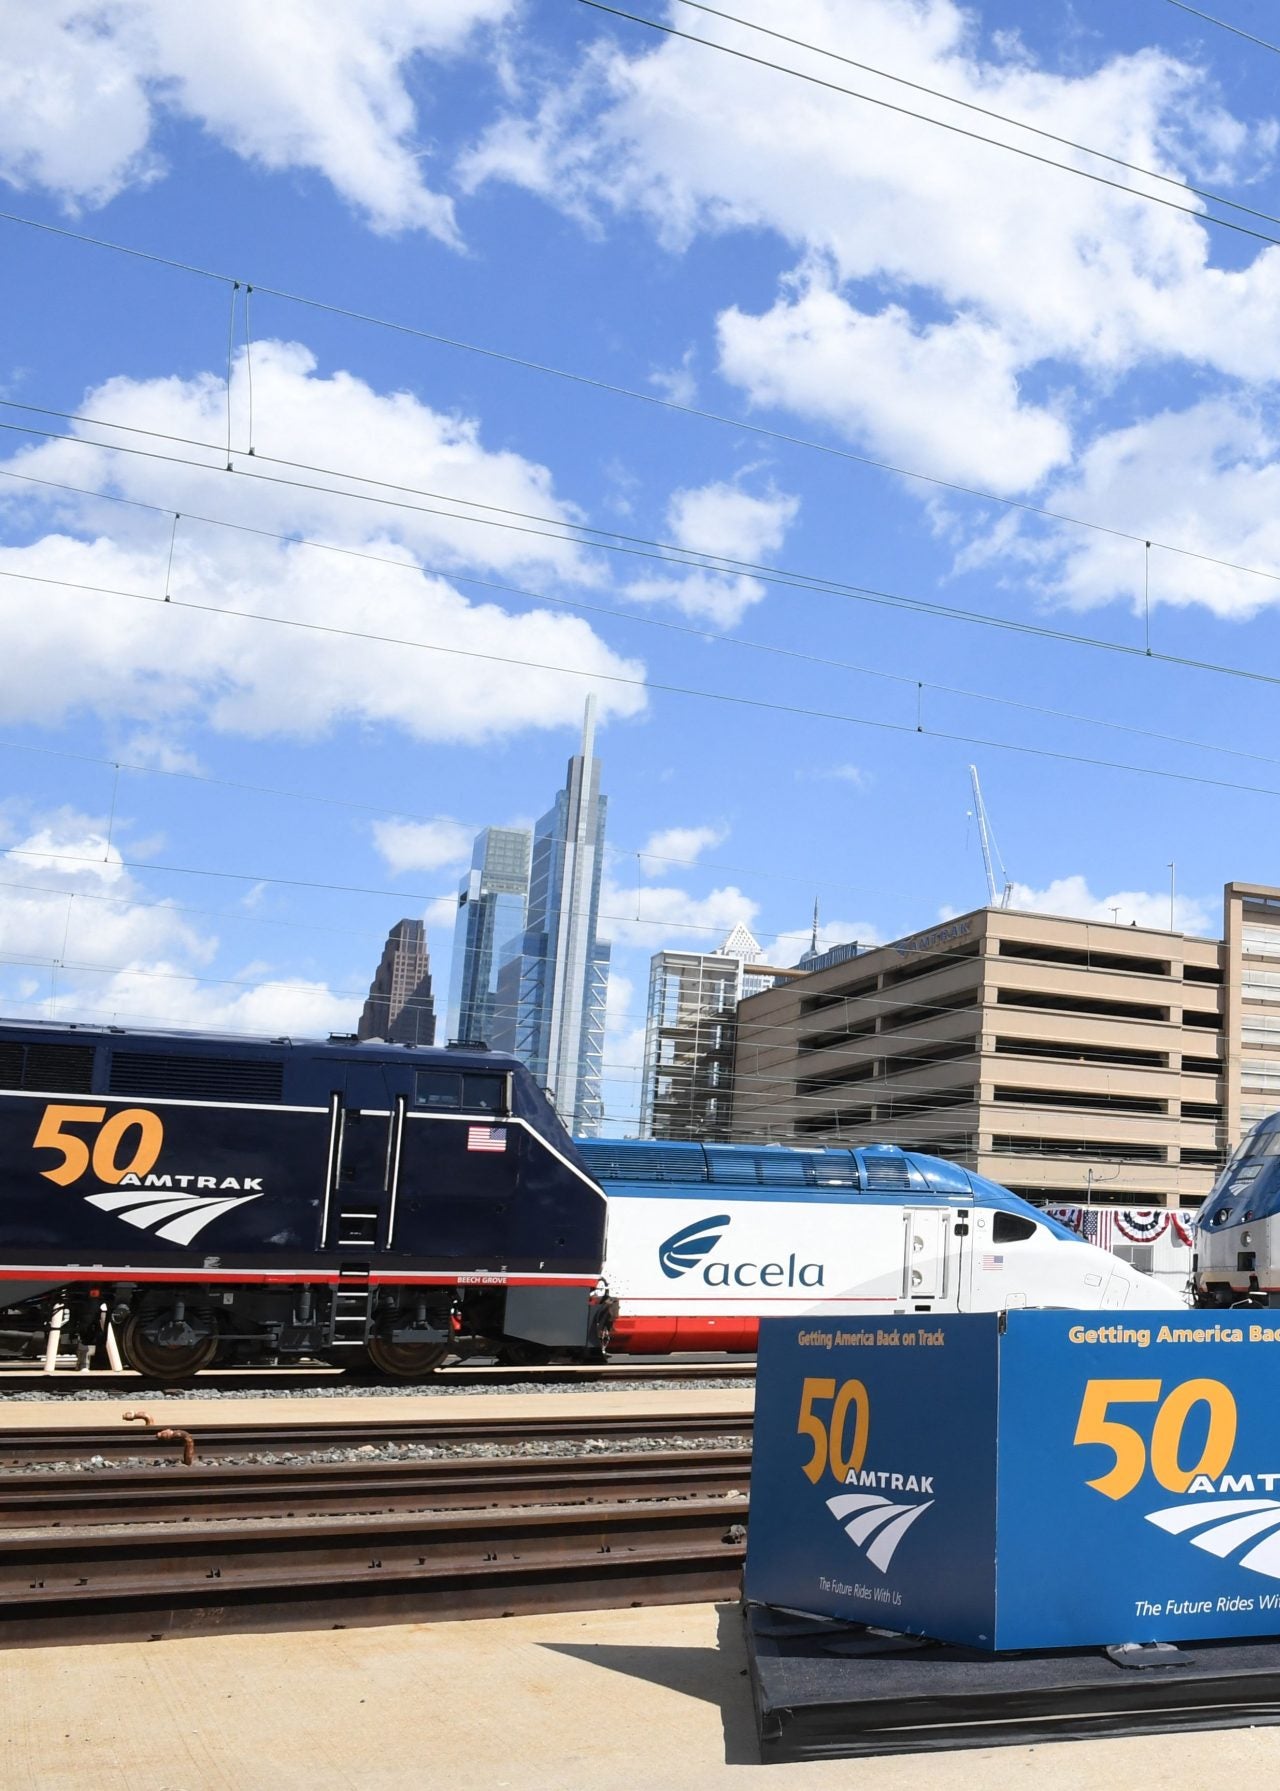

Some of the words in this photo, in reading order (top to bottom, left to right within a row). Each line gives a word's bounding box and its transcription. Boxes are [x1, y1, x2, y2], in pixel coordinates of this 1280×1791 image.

[911, 922, 971, 950] AMTRAK
[32, 1104, 164, 1187] 50
[120, 1173, 263, 1192] AMTRAK
[457, 1276, 481, 1284] BEECH
[703, 1253, 824, 1288] acela
[798, 1329, 832, 1349] Getting
[834, 1330, 874, 1346] America
[876, 1329, 900, 1346] Back
[902, 1332, 916, 1346] on
[918, 1329, 945, 1346] Track
[1069, 1325, 1151, 1347] Getting
[1156, 1325, 1243, 1342] America
[797, 1377, 871, 1485] 50
[1073, 1378, 1238, 1500] 50
[844, 1469, 935, 1494] AMTRAK
[819, 1577, 831, 1592] The
[831, 1579, 852, 1596] Future
[853, 1583, 872, 1600] Rides
[873, 1587, 891, 1603] With
[892, 1592, 902, 1606] Us
[1135, 1601, 1161, 1616] The
[1166, 1599, 1212, 1615] Future
[1217, 1596, 1254, 1612] Rides
